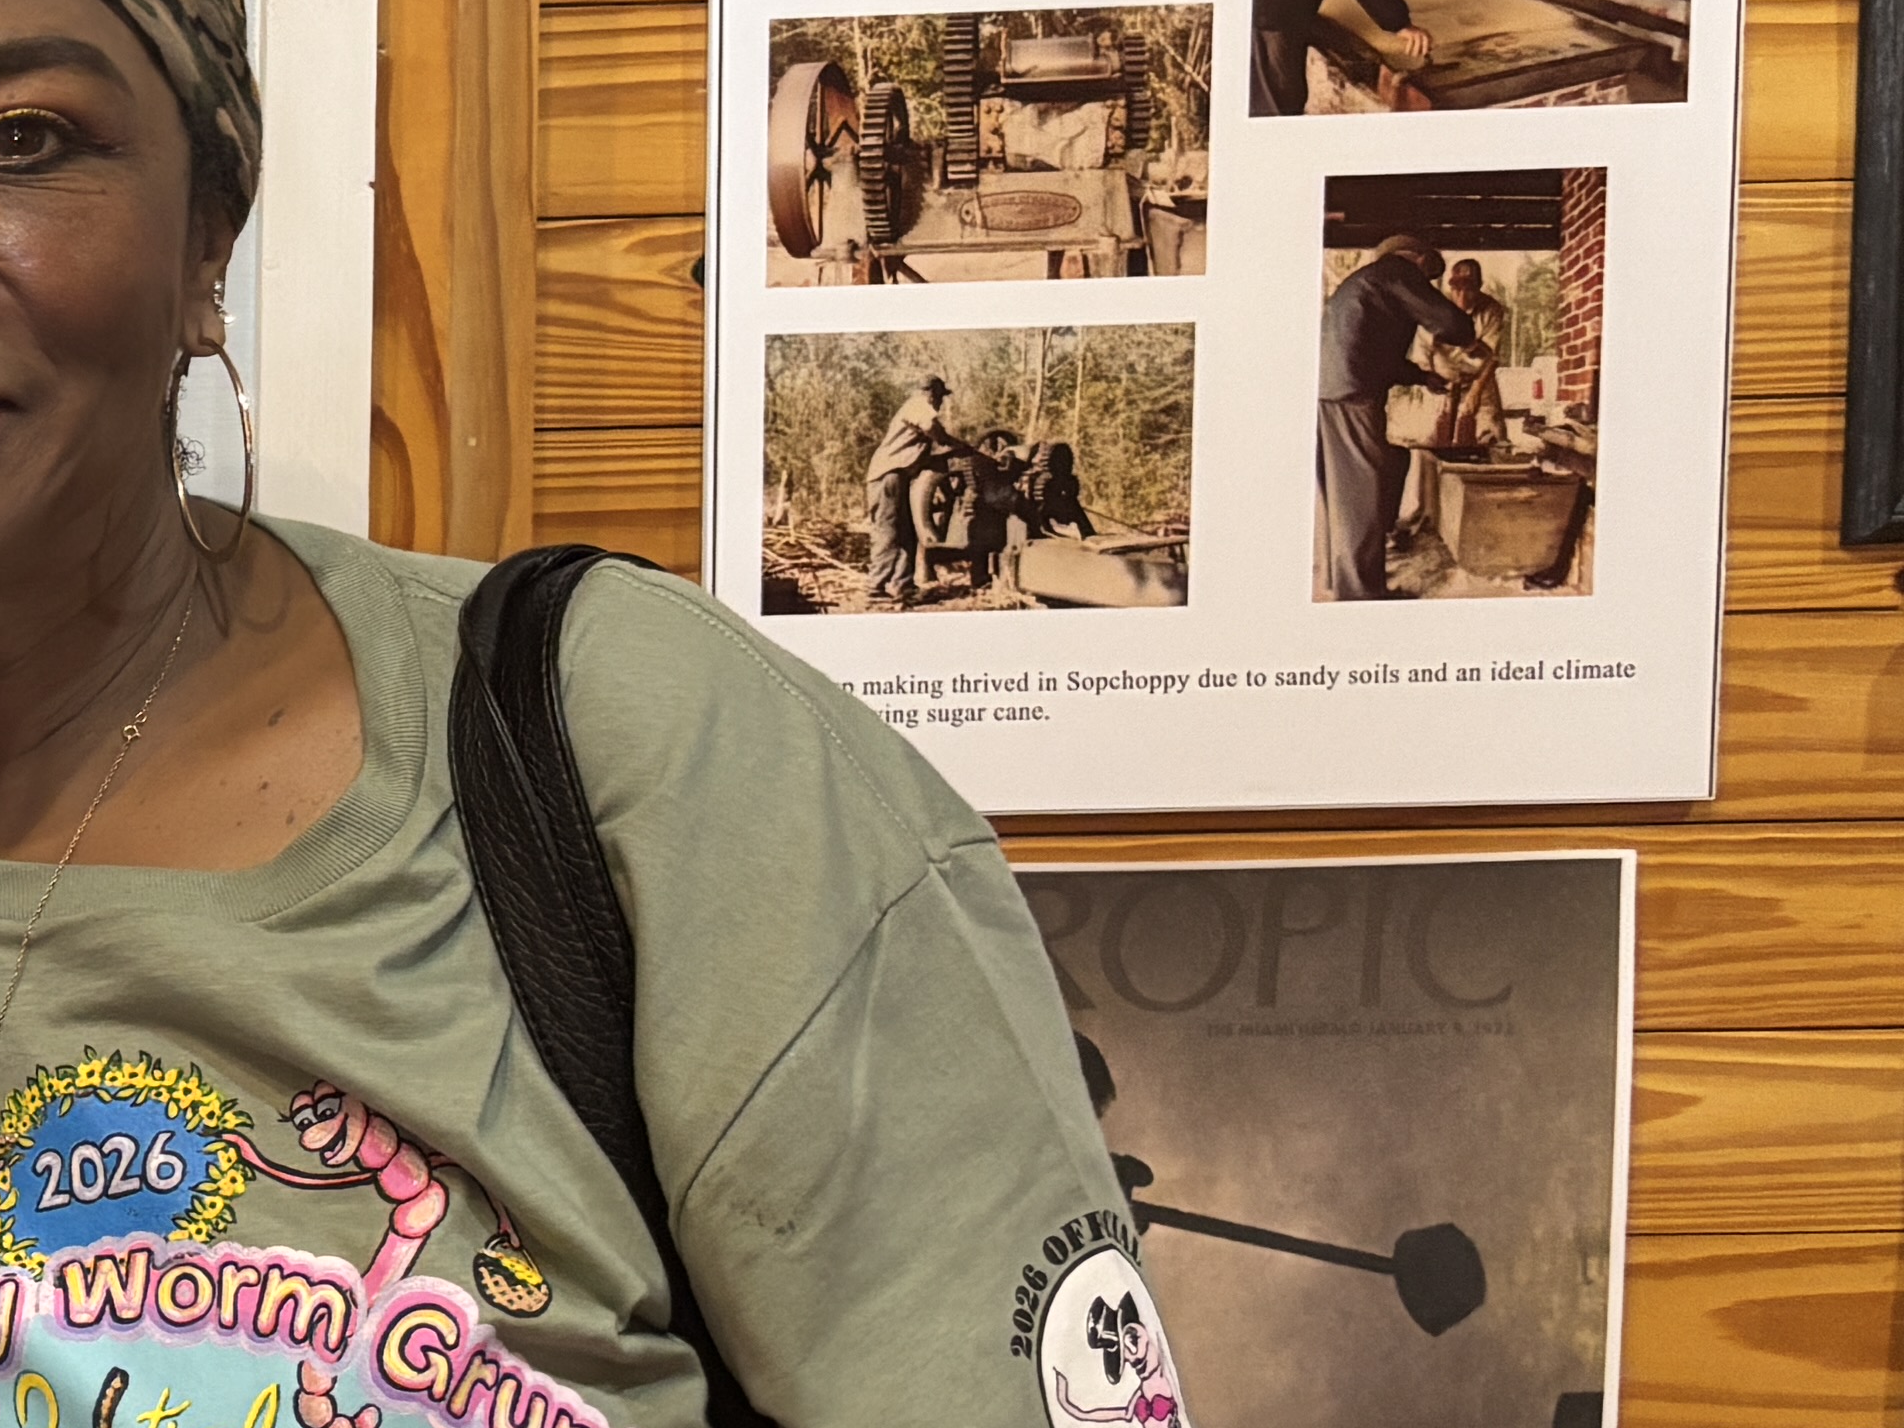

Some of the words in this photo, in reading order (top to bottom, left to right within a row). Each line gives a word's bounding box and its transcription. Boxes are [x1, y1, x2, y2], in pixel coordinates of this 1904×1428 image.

[862, 674, 944, 699] making
[952, 671, 1029, 694] thrived
[1038, 671, 1057, 692] in
[1067, 669, 1190, 696] Sopchoppy
[1198, 667, 1238, 688] due
[1246, 670, 1267, 687] to
[1275, 665, 1340, 691] sandy
[1348, 663, 1400, 685] soils
[1408, 662, 1447, 683] and
[1456, 667, 1481, 682] an
[1491, 660, 1544, 682] ideal
[1552, 659, 1636, 680] climate
[926, 707, 987, 728] sugar
[992, 705, 1050, 722] cane.
[1018, 873, 1512, 1012] ROPIC
[34, 1131, 189, 1214] 2026
[64, 1250, 348, 1358] Worm
[1010, 1264, 1048, 1360] 2026
